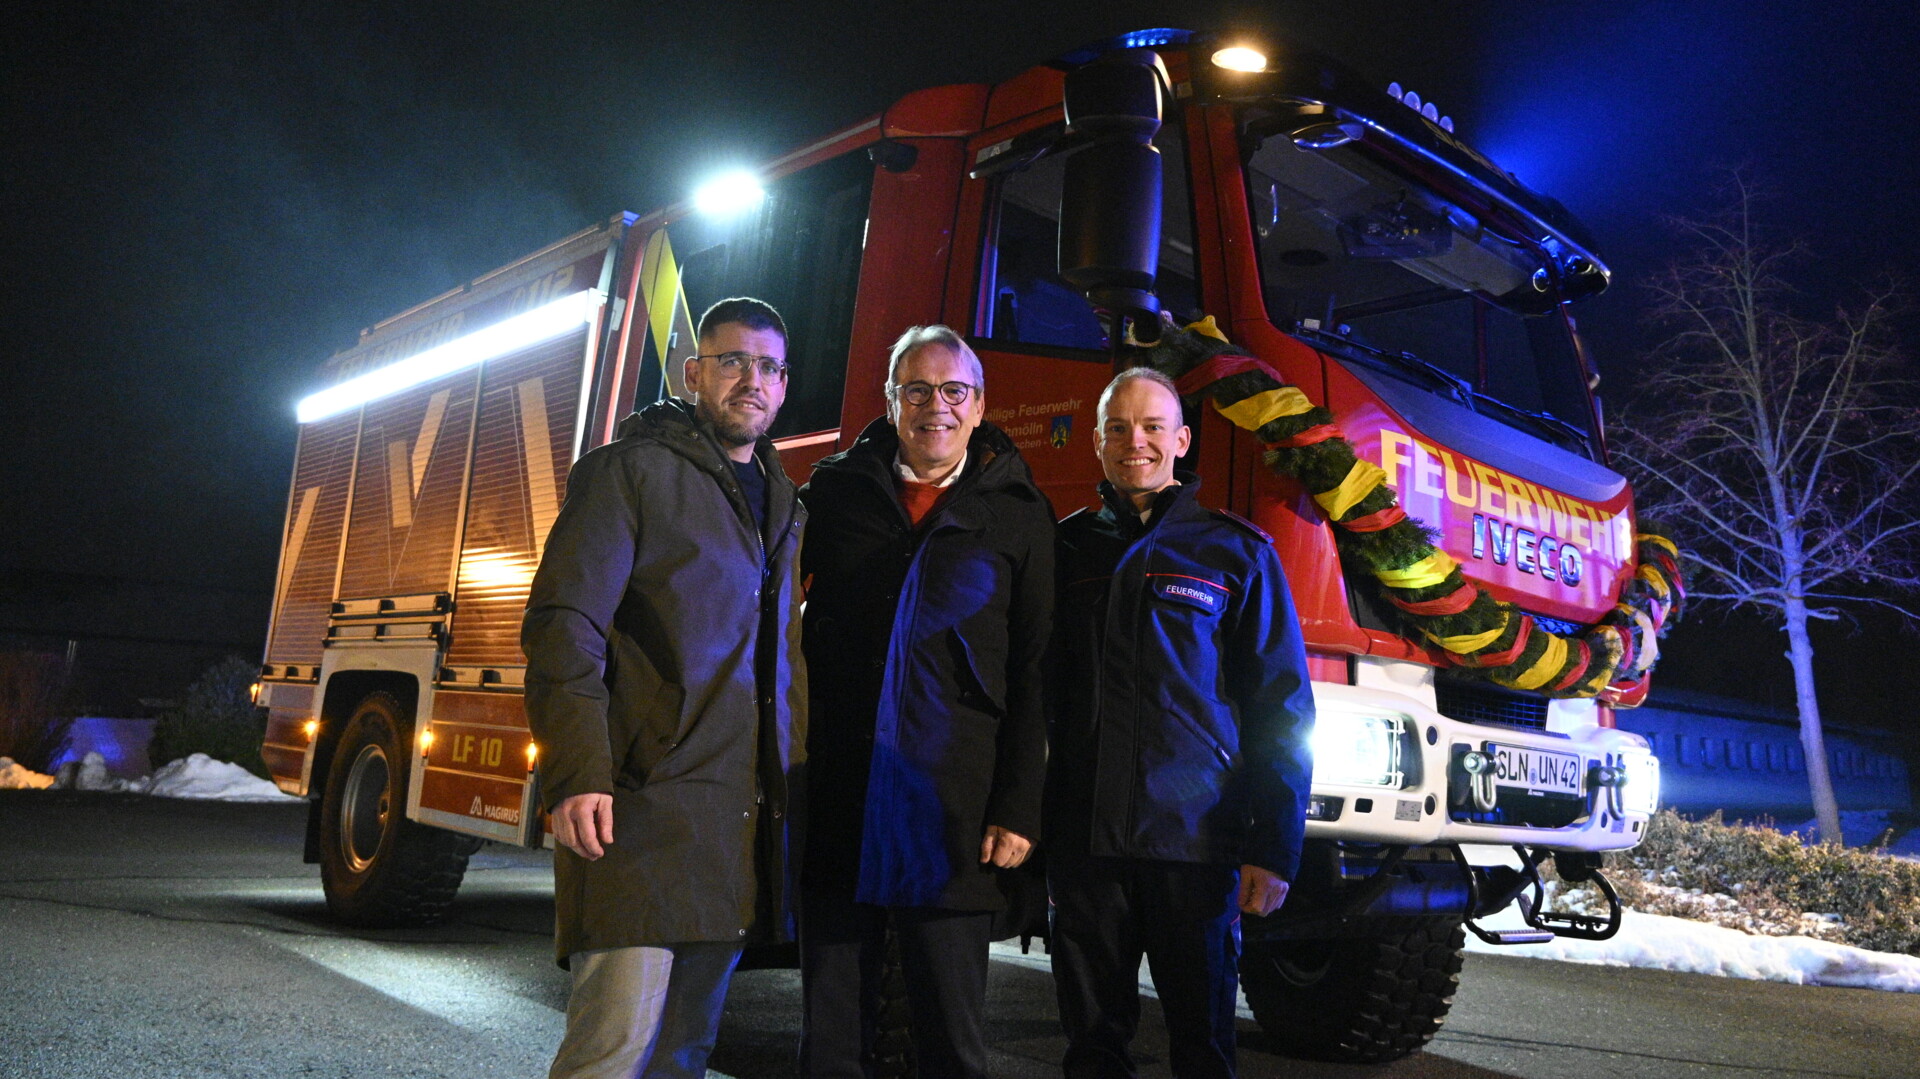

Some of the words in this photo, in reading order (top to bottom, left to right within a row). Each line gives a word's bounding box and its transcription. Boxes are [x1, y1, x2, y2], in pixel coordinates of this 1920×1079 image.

[1018, 399, 1083, 417] Feuerwehr
[1004, 422, 1043, 437] hmölln
[1472, 513, 1583, 587] IVECO
[1166, 584, 1214, 604] FEUERWEHR
[452, 734, 475, 763] LF
[480, 737, 503, 767] 10
[1497, 750, 1528, 781] SLN
[1539, 755, 1557, 785] UN
[1561, 761, 1576, 788] 42
[484, 805, 519, 822] MAGIRUS
